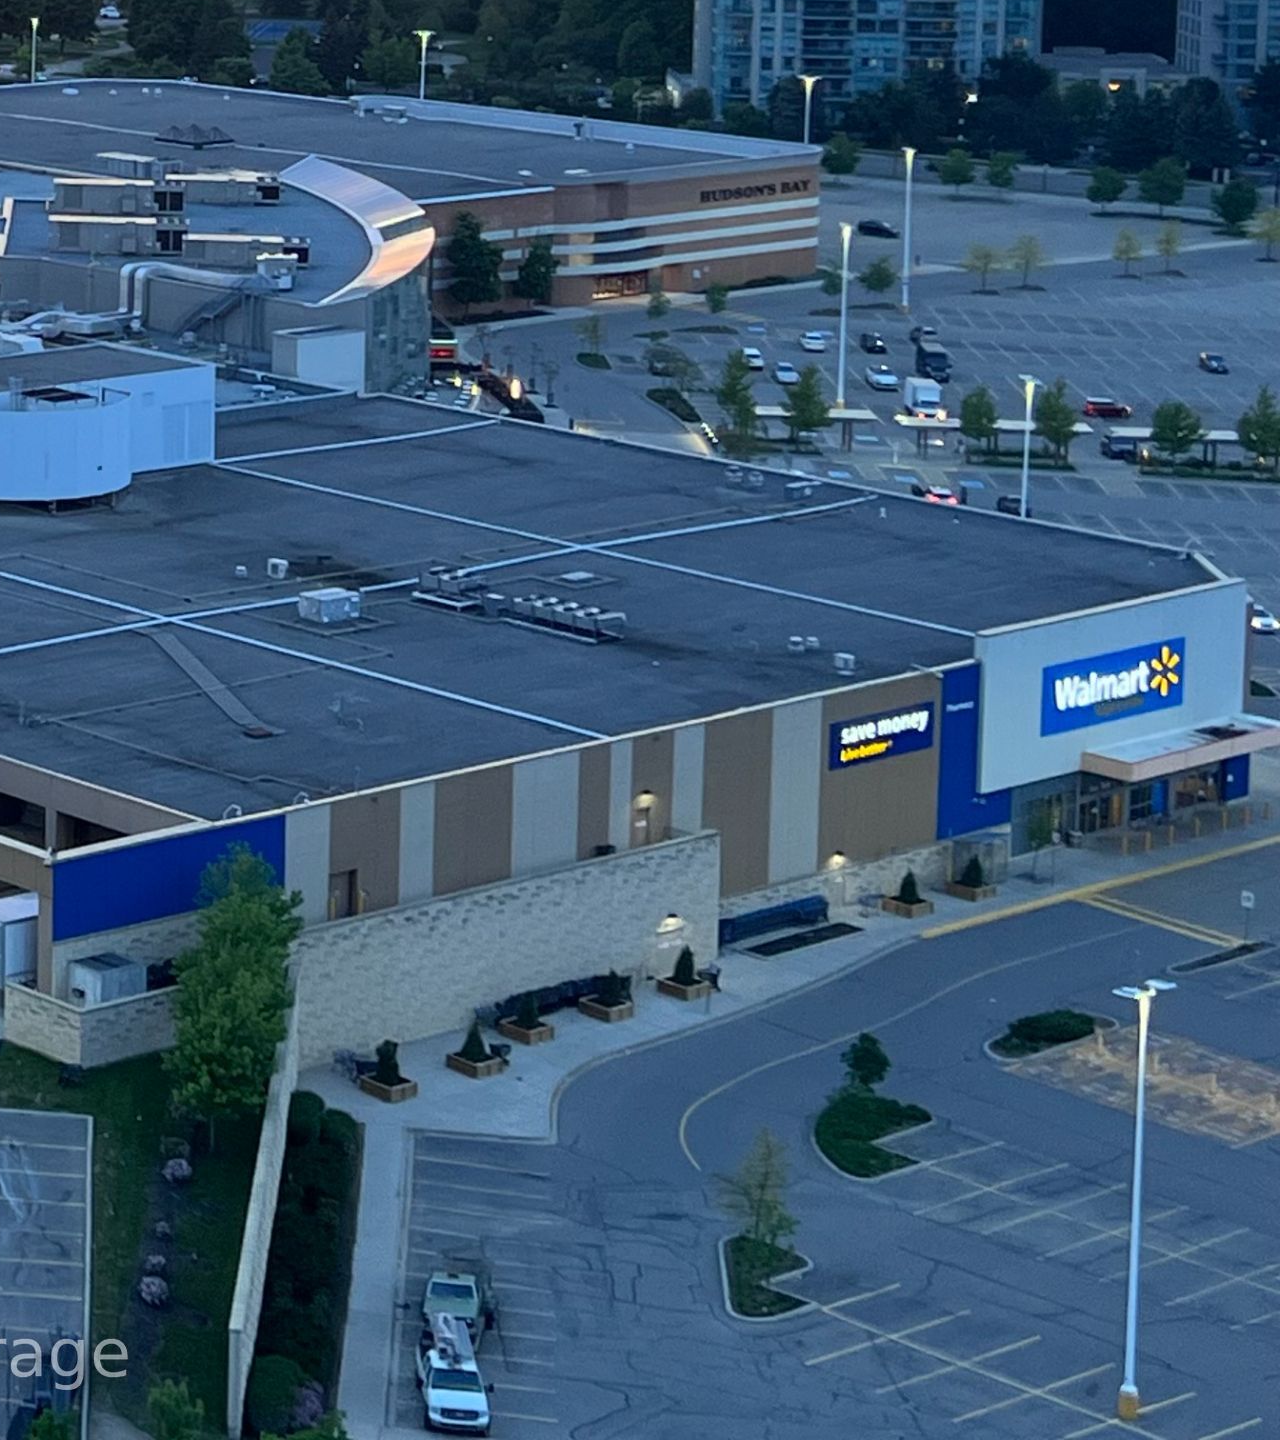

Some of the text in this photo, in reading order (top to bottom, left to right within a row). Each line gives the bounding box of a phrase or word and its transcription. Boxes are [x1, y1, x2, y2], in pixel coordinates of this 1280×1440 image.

[700, 179, 811, 203] HUDSON'S BAY
[1054, 660, 1150, 711] Walmart
[841, 710, 929, 745] save money
